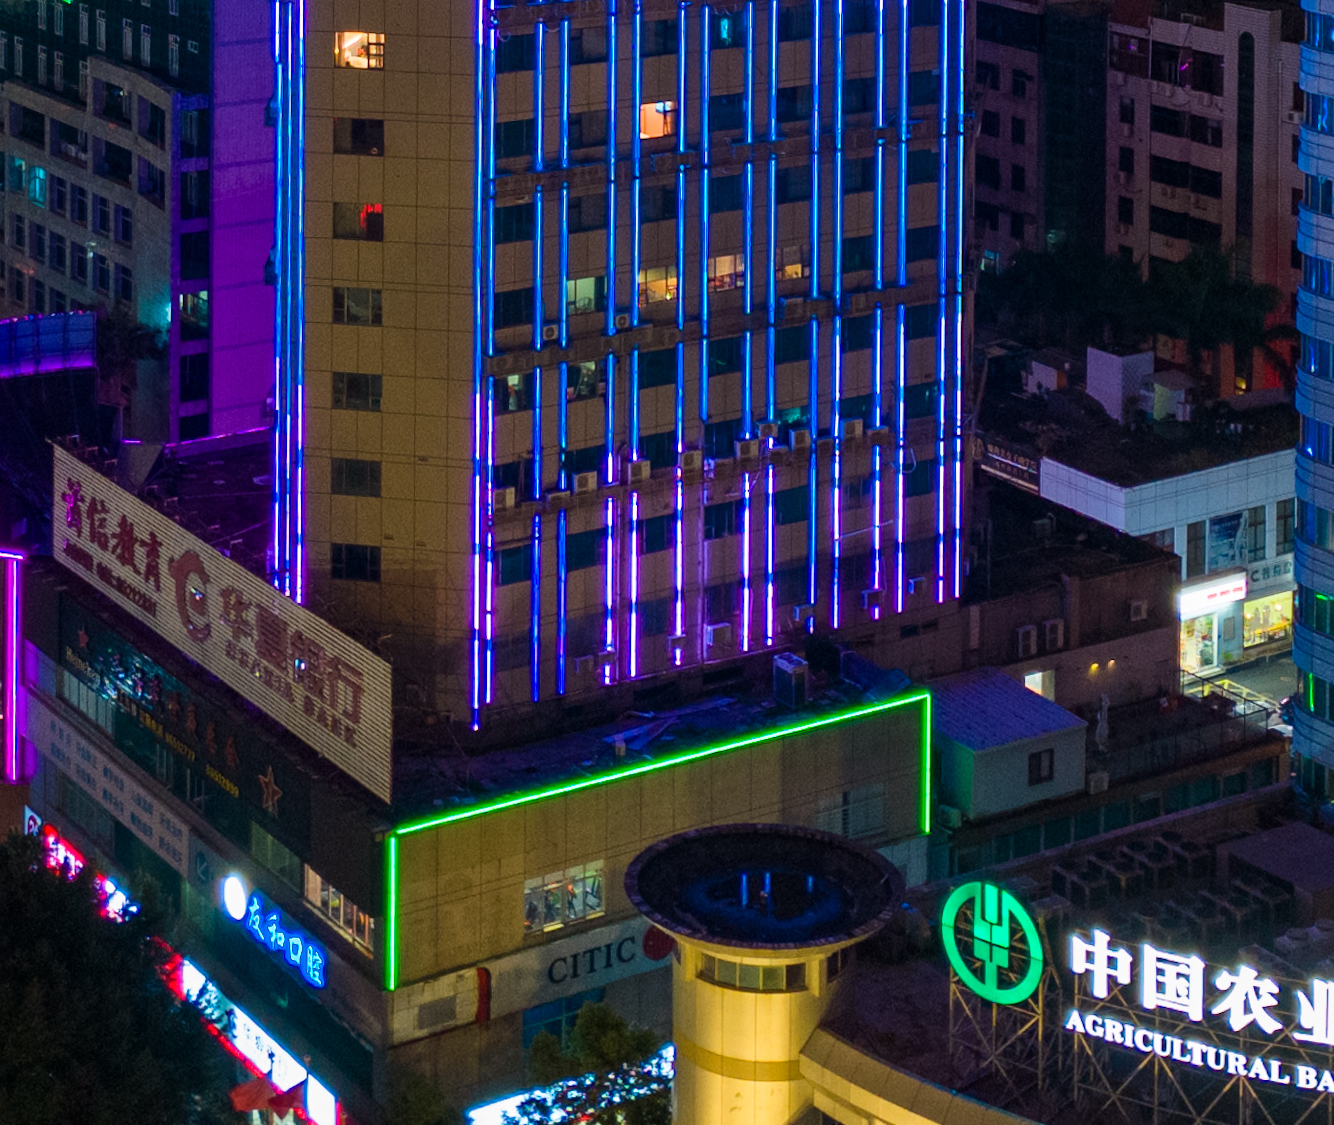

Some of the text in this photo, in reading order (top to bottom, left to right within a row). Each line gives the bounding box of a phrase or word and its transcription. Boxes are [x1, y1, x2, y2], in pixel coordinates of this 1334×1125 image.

[220, 585, 364, 724] 华夏银行
[248, 897, 323, 985] 友和口腔
[547, 935, 636, 985] CITIC
[1066, 1011, 1291, 1085] AGRICULTURAL
